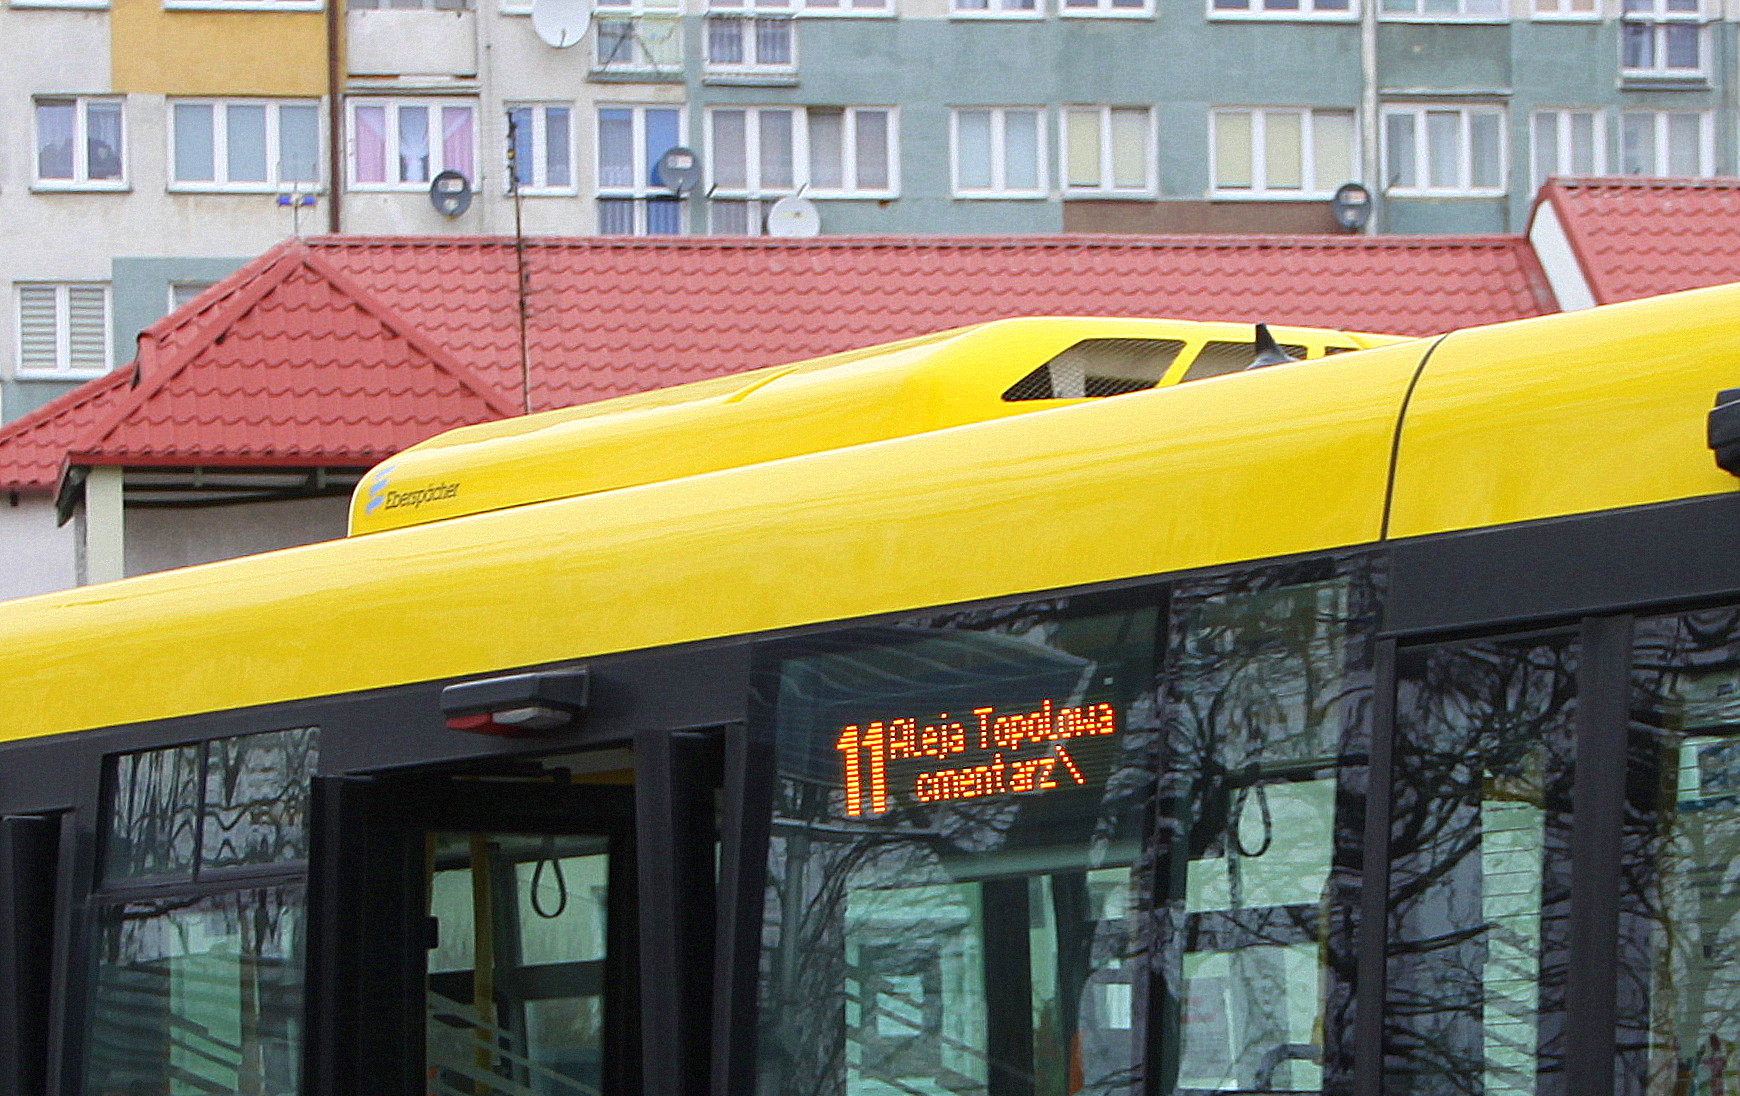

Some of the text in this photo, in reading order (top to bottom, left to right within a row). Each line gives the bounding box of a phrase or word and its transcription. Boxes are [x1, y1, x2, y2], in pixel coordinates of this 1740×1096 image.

[889, 699, 1116, 759] Aleja Topolowa
[837, 721, 886, 816] 11
